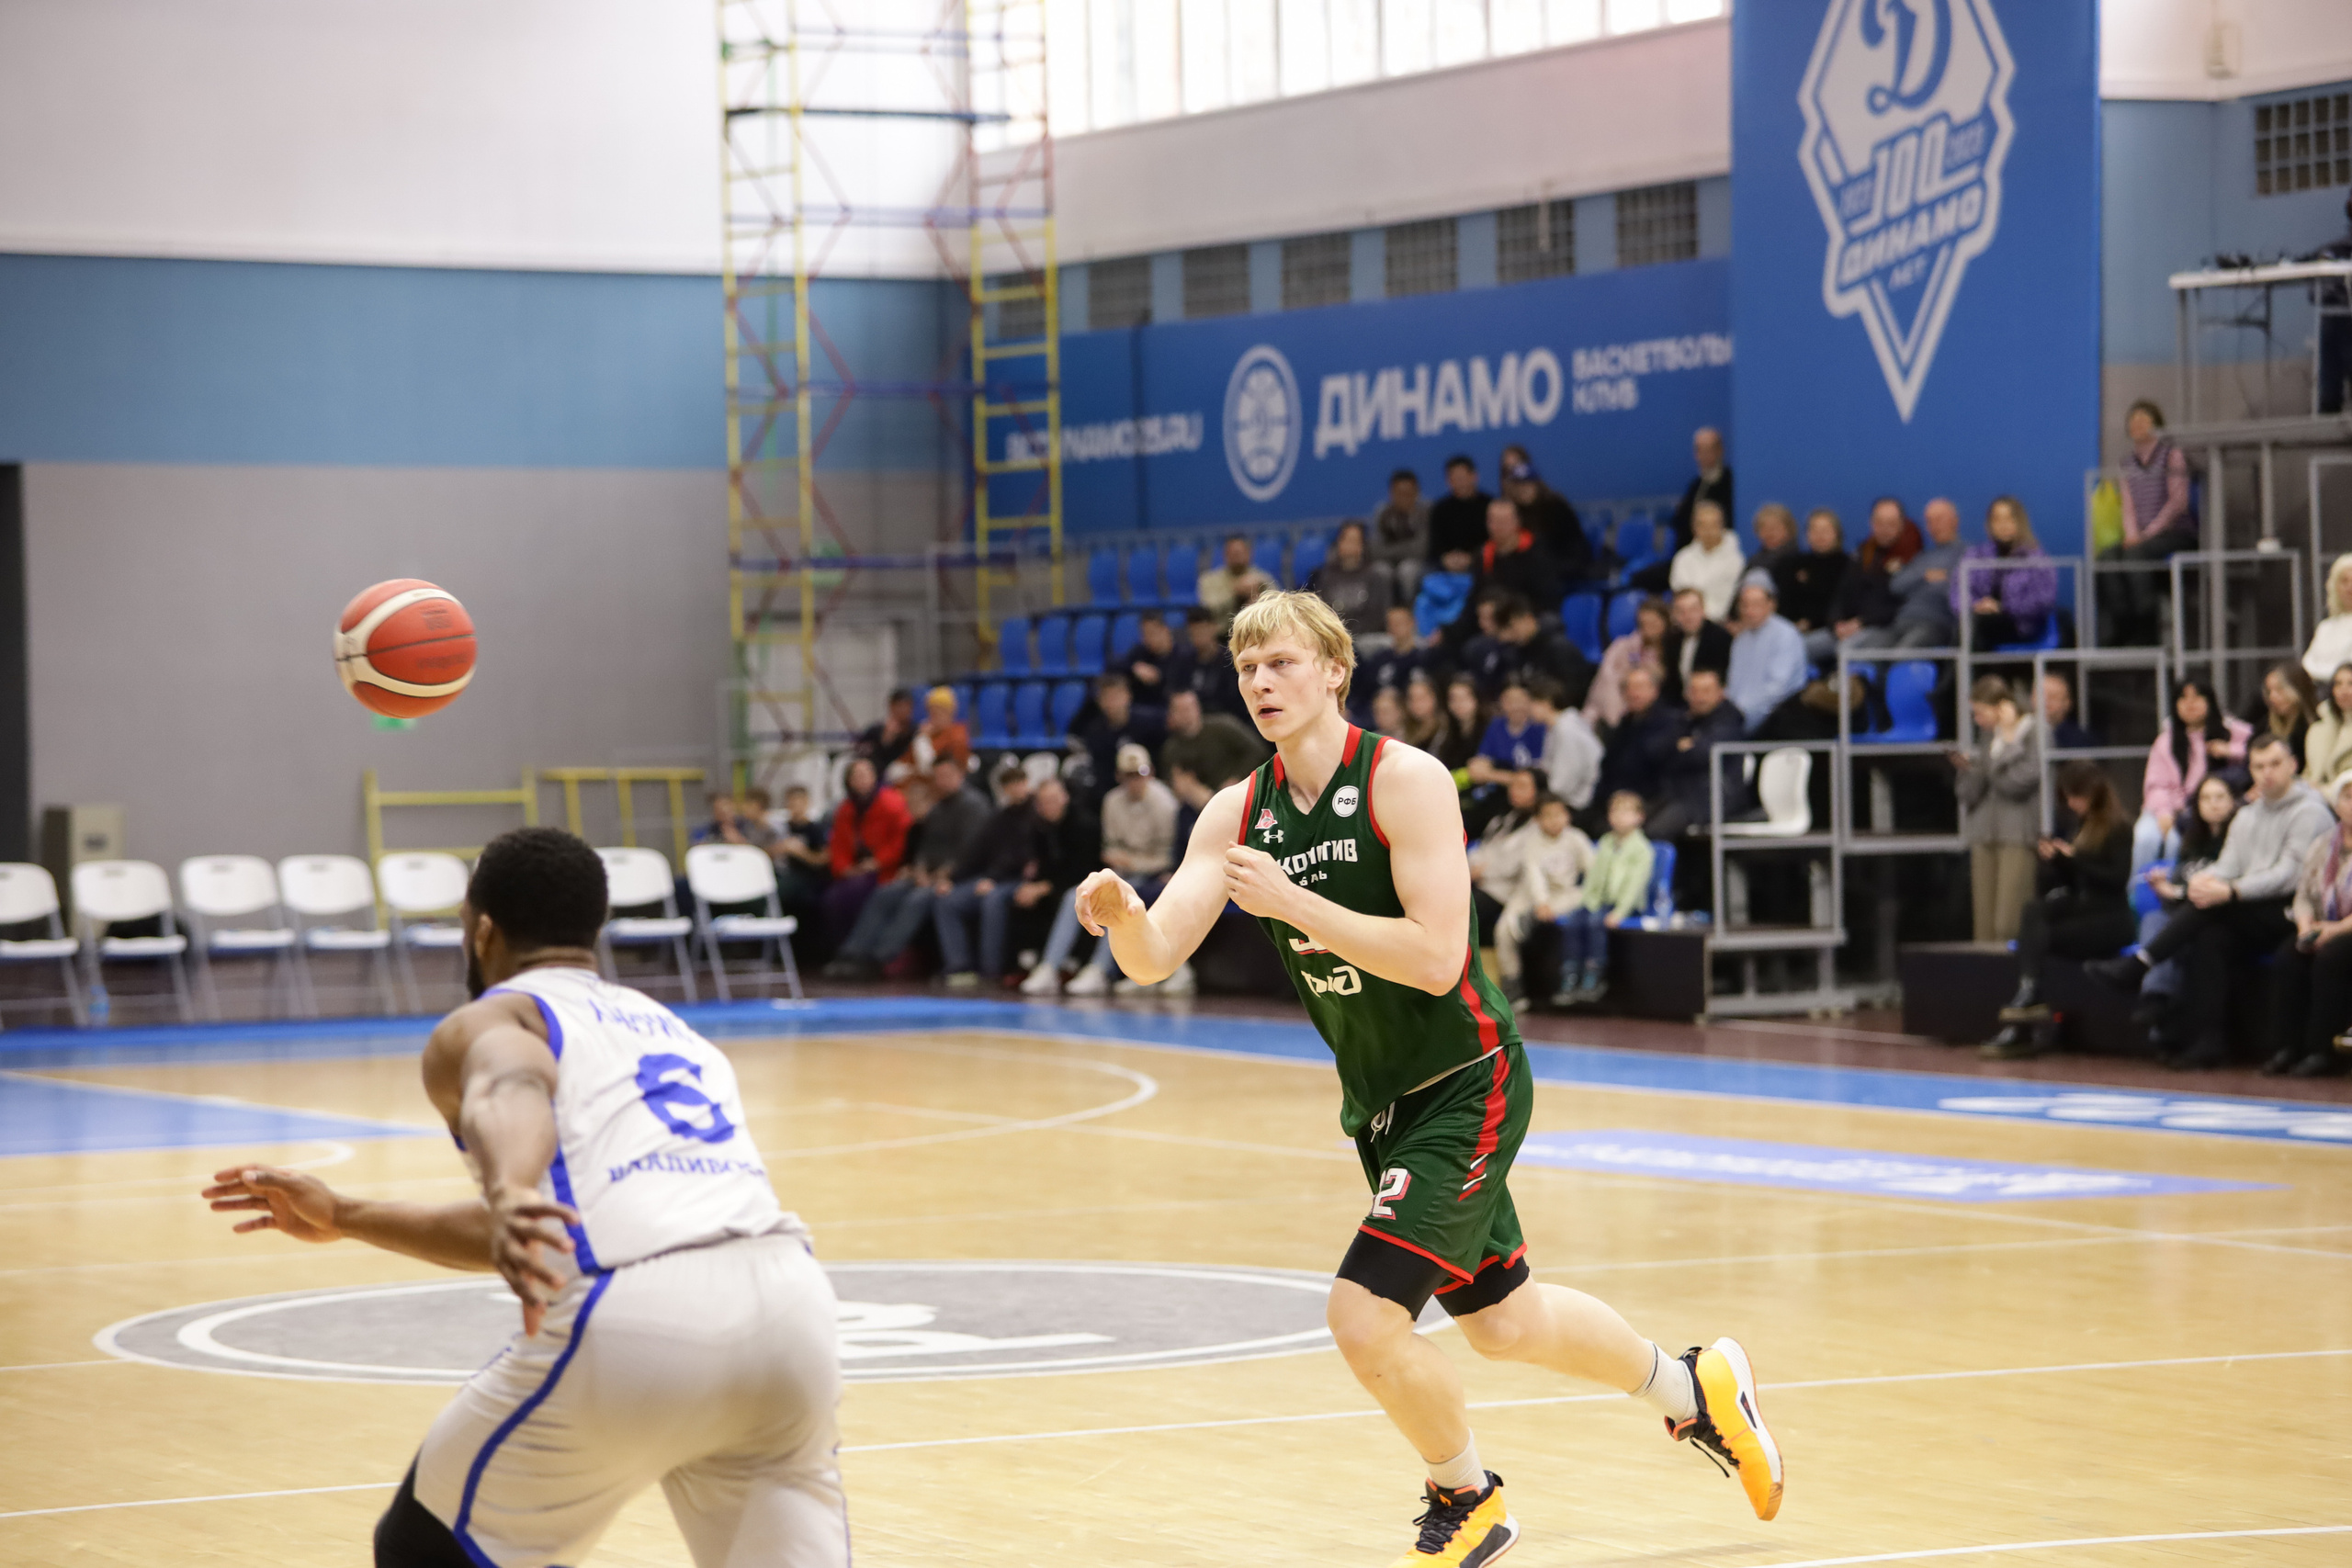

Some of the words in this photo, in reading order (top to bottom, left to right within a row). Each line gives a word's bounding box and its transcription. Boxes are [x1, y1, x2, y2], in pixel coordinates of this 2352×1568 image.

[1840, 184, 1984, 282] ДИНАМО
[1313, 347, 1562, 457] ДИНАМО
[1337, 796, 1357, 807] РФБ
[635, 1053, 735, 1145] 6
